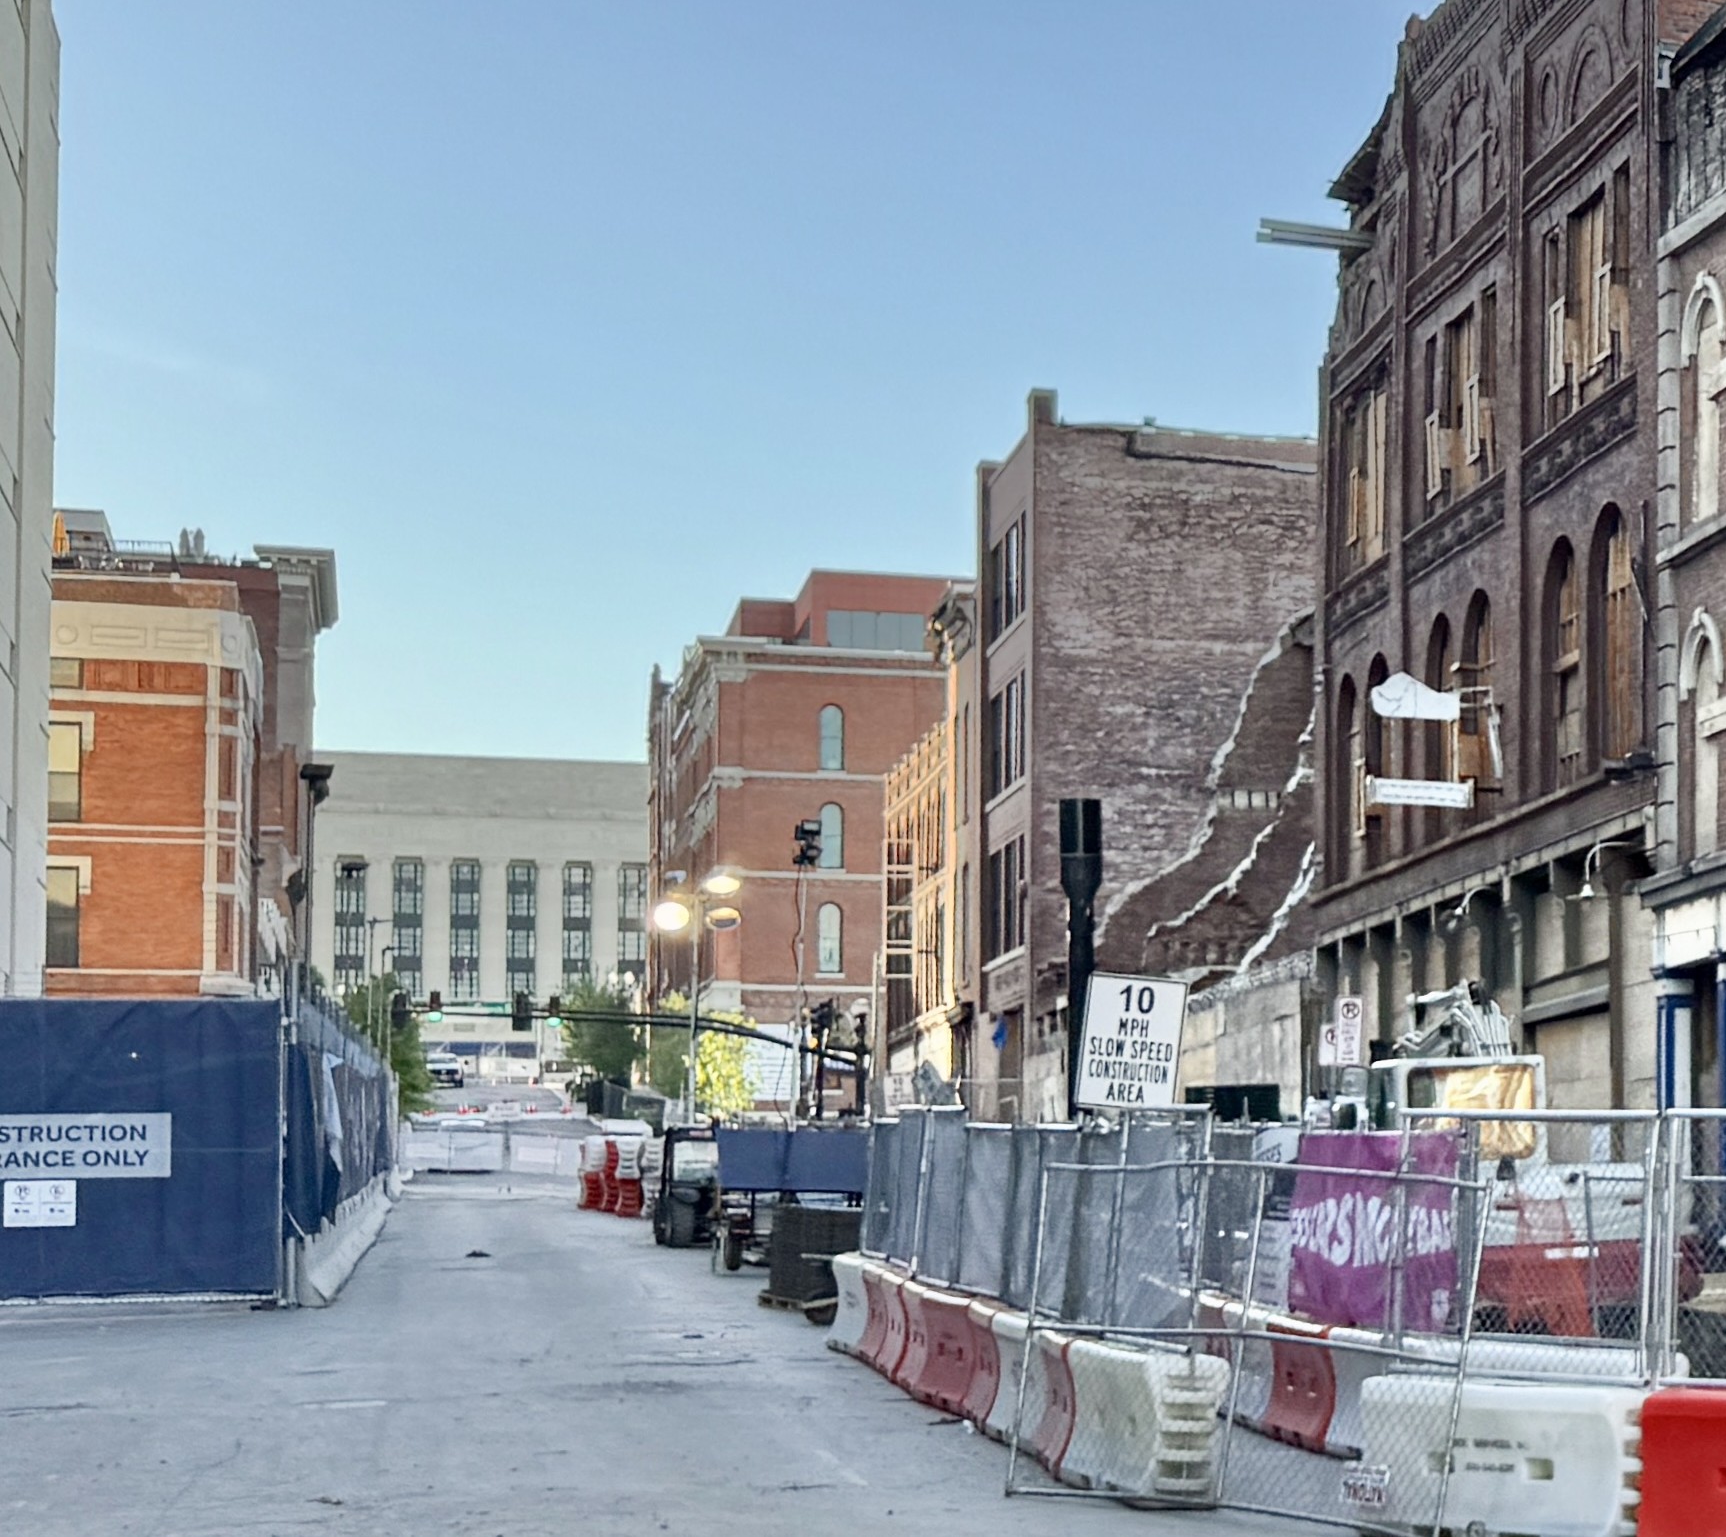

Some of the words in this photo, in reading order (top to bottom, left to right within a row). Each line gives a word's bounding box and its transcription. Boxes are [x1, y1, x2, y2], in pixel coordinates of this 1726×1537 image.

[1119, 984, 1155, 1014] 10
[1118, 1017, 1150, 1038] MPH
[1089, 1036, 1126, 1057] SLOW
[1130, 1040, 1173, 1062] SPEED
[1088, 1058, 1169, 1084] CONSTRUCTION
[1105, 1082, 1145, 1104] AREA
[0, 1124, 148, 1143] STRUCTION
[0, 1150, 76, 1168] ANCE
[82, 1148, 149, 1167] ONLY
